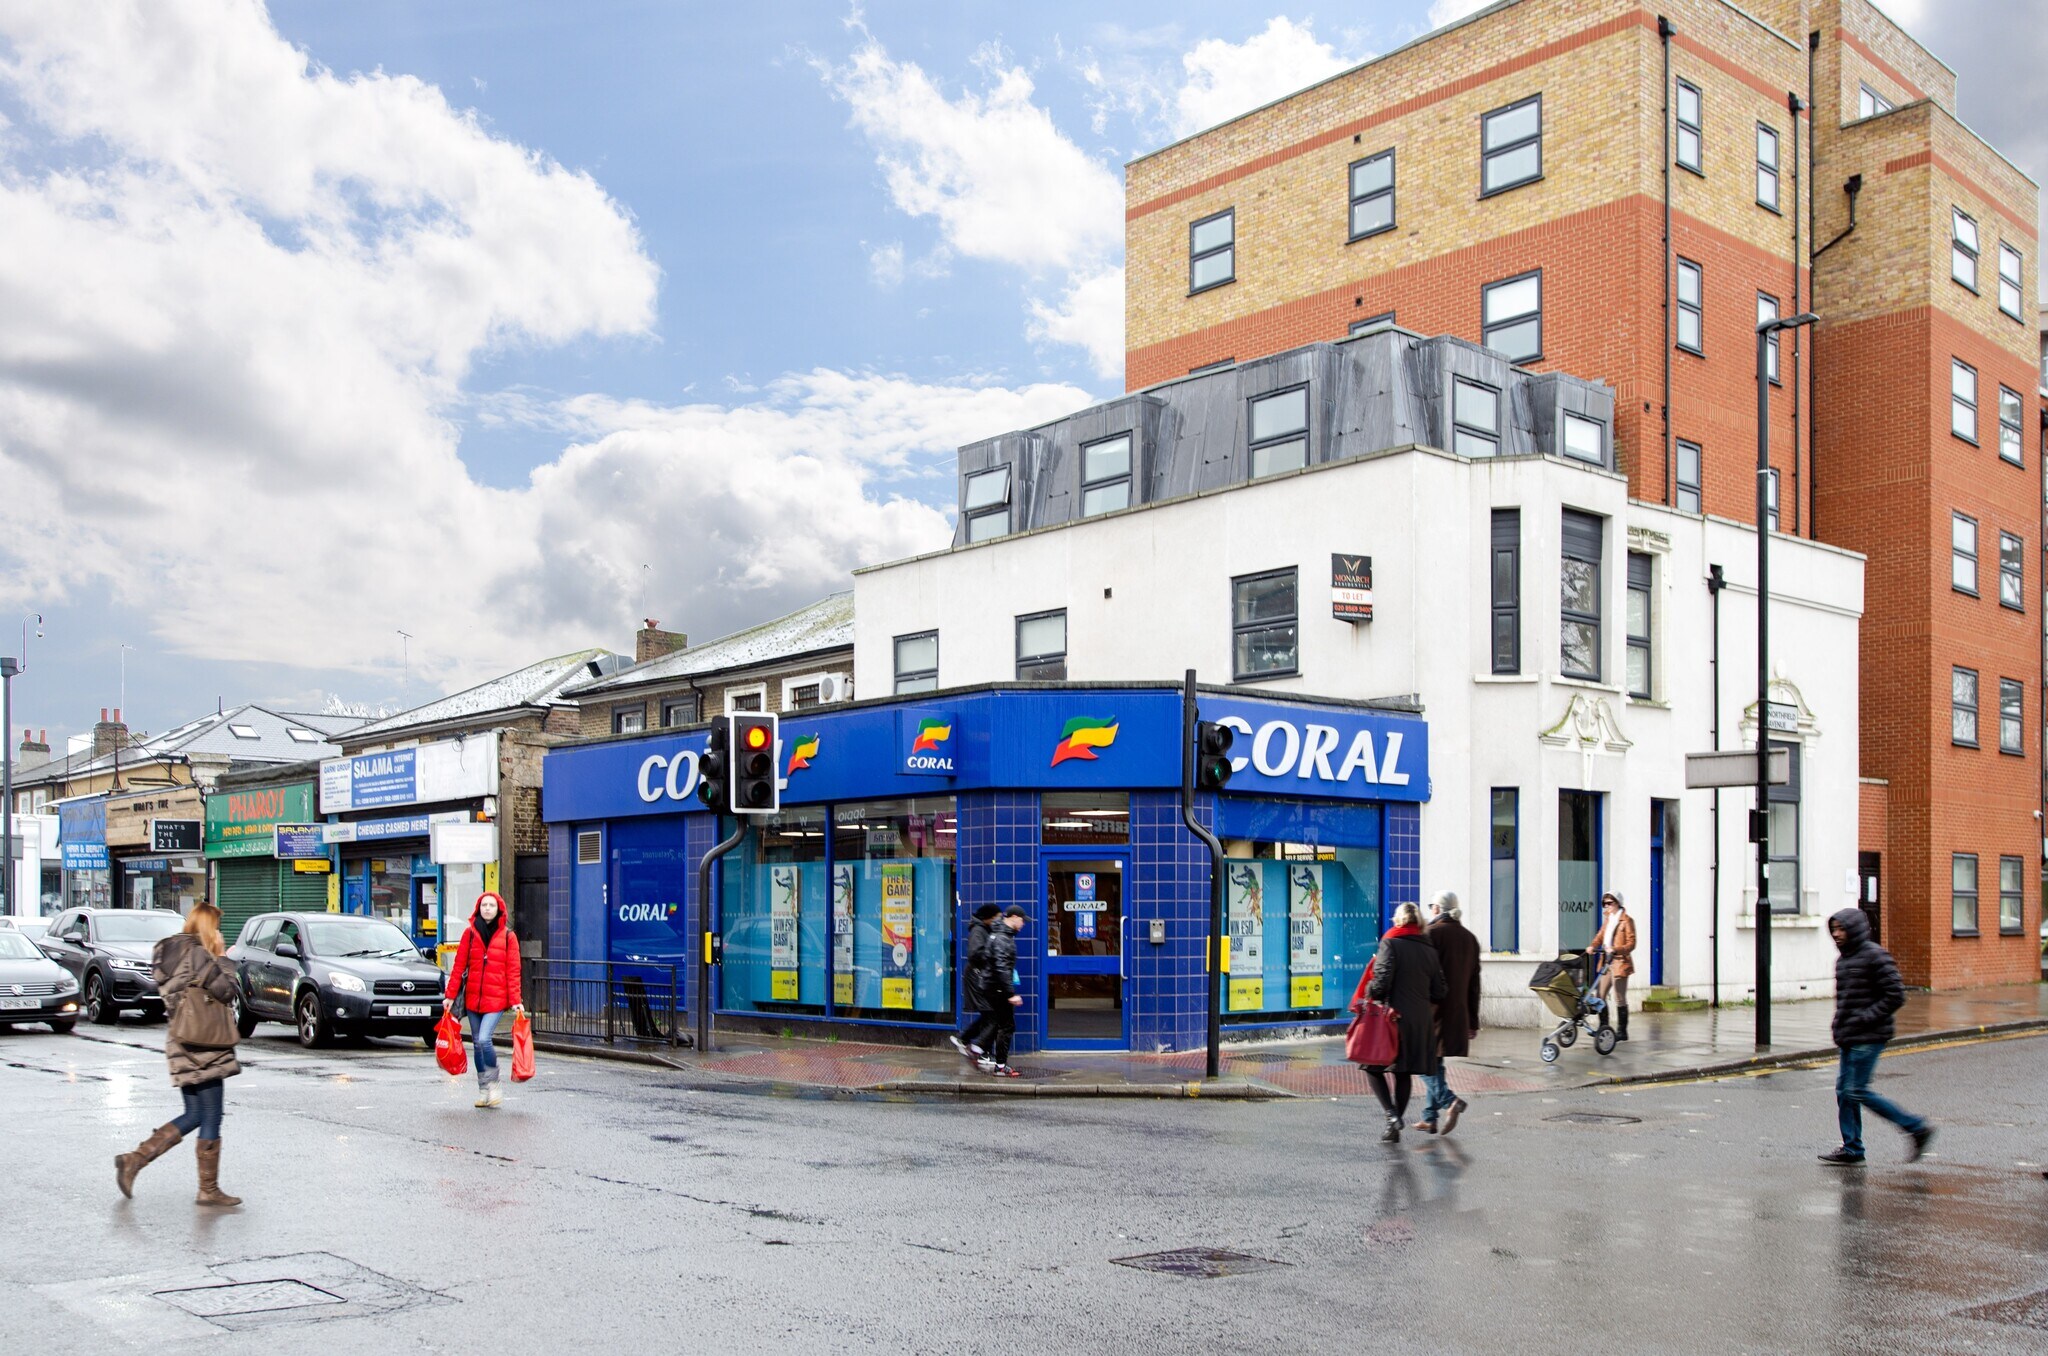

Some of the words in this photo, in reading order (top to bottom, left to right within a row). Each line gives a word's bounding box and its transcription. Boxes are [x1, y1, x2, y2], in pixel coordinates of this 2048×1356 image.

[1334, 575, 1370, 583] MONARCH
[1342, 592, 1350, 600] TO
[1767, 711, 1796, 720] NORTHFIELD
[1768, 721, 1786, 729] AVENUE
[354, 757, 393, 779] SALAMA
[394, 753, 413, 763] INTERNET
[907, 756, 954, 771] CORAL
[134, 801, 153, 812] WHAT'S
[158, 799, 168, 809] THE
[229, 788, 285, 822] PHARO'S
[358, 823, 385, 836] CHEQUES
[385, 821, 410, 834] CASHED
[411, 819, 428, 831] HERE
[67, 844, 79, 853] HAIR
[80, 844, 85, 853] &
[85, 844, 105, 853] BEAUTY
[158, 838, 180, 848] 211
[67, 860, 77, 868] 020
[887, 874, 901, 883] THE
[887, 884, 911, 896] GAME
[1065, 902, 1101, 910] CORAL
[1559, 901, 1589, 913] ORAL
[619, 903, 668, 922] CORAL
[773, 918, 784, 932] WIN
[1230, 920, 1239, 935] WIN
[1241, 920, 1253, 935] £50
[1292, 920, 1300, 934] WIN
[1301, 920, 1314, 934] £50
[773, 933, 788, 947] CASH
[1292, 936, 1304, 950] CASH
[396, 1007, 406, 1015] L7
[408, 1007, 422, 1015] CJA
